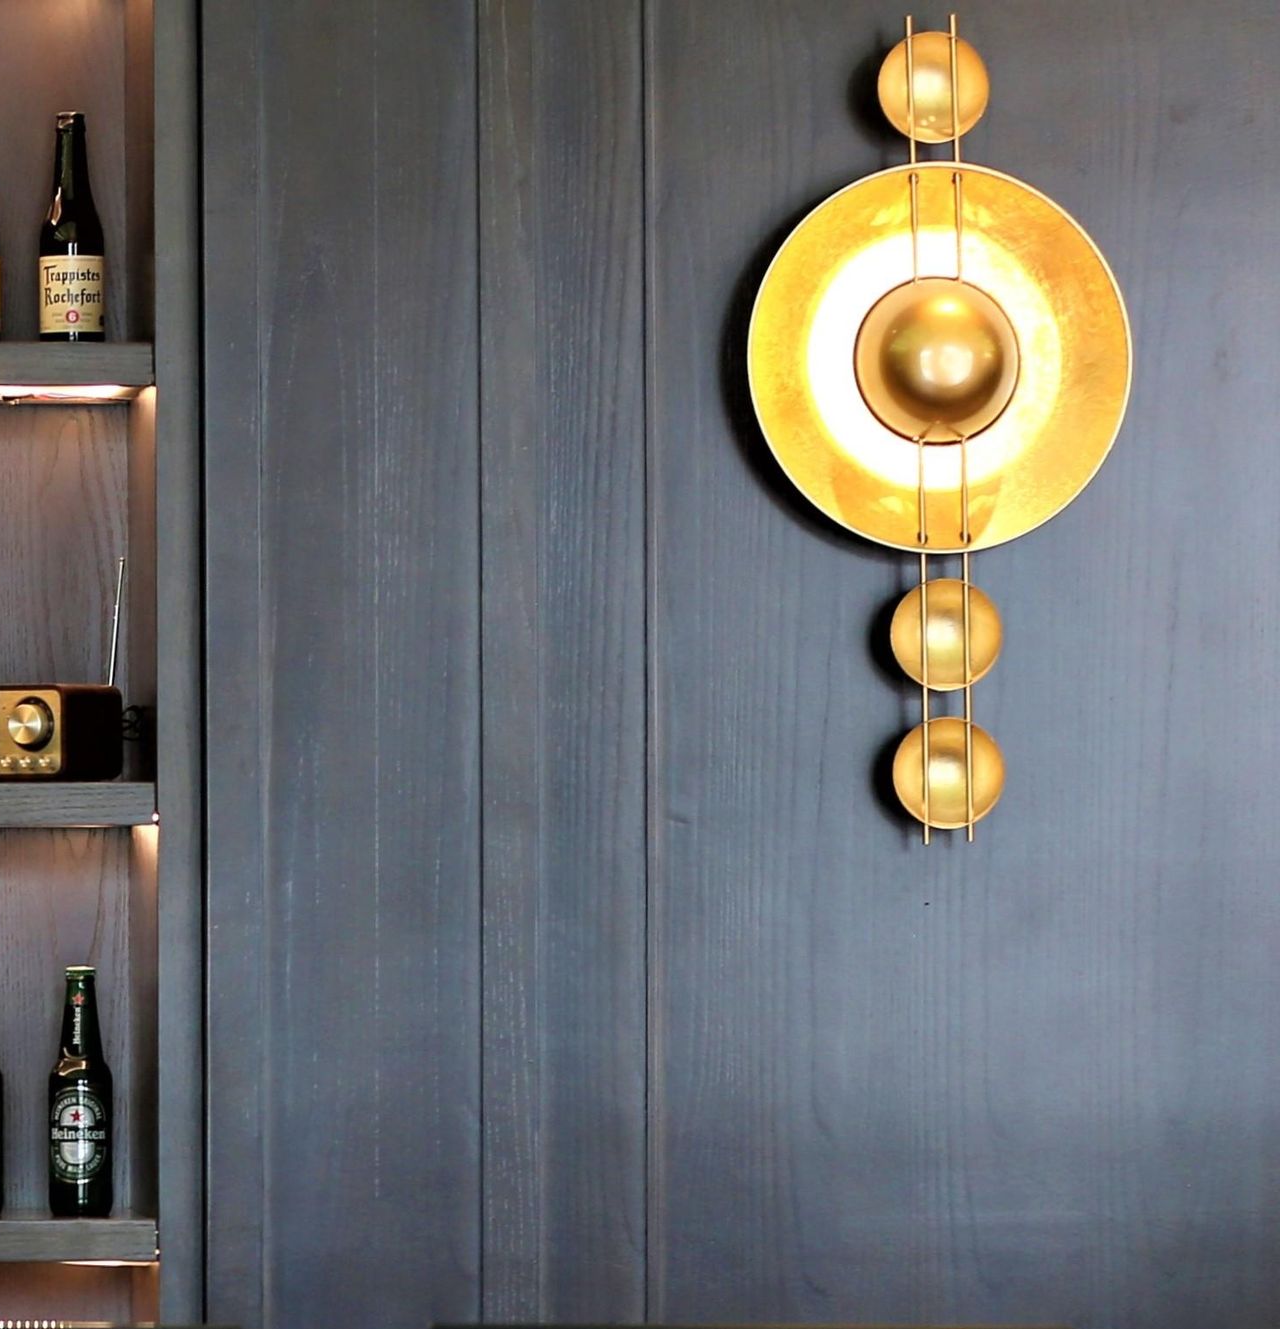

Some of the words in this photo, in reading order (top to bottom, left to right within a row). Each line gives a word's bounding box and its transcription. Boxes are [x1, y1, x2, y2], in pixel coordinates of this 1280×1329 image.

[43, 265, 100, 285] Trappistes
[44, 287, 101, 307] Rochefort
[72, 1007, 81, 1045] Heineken
[51, 1128, 105, 1140] Heineken
